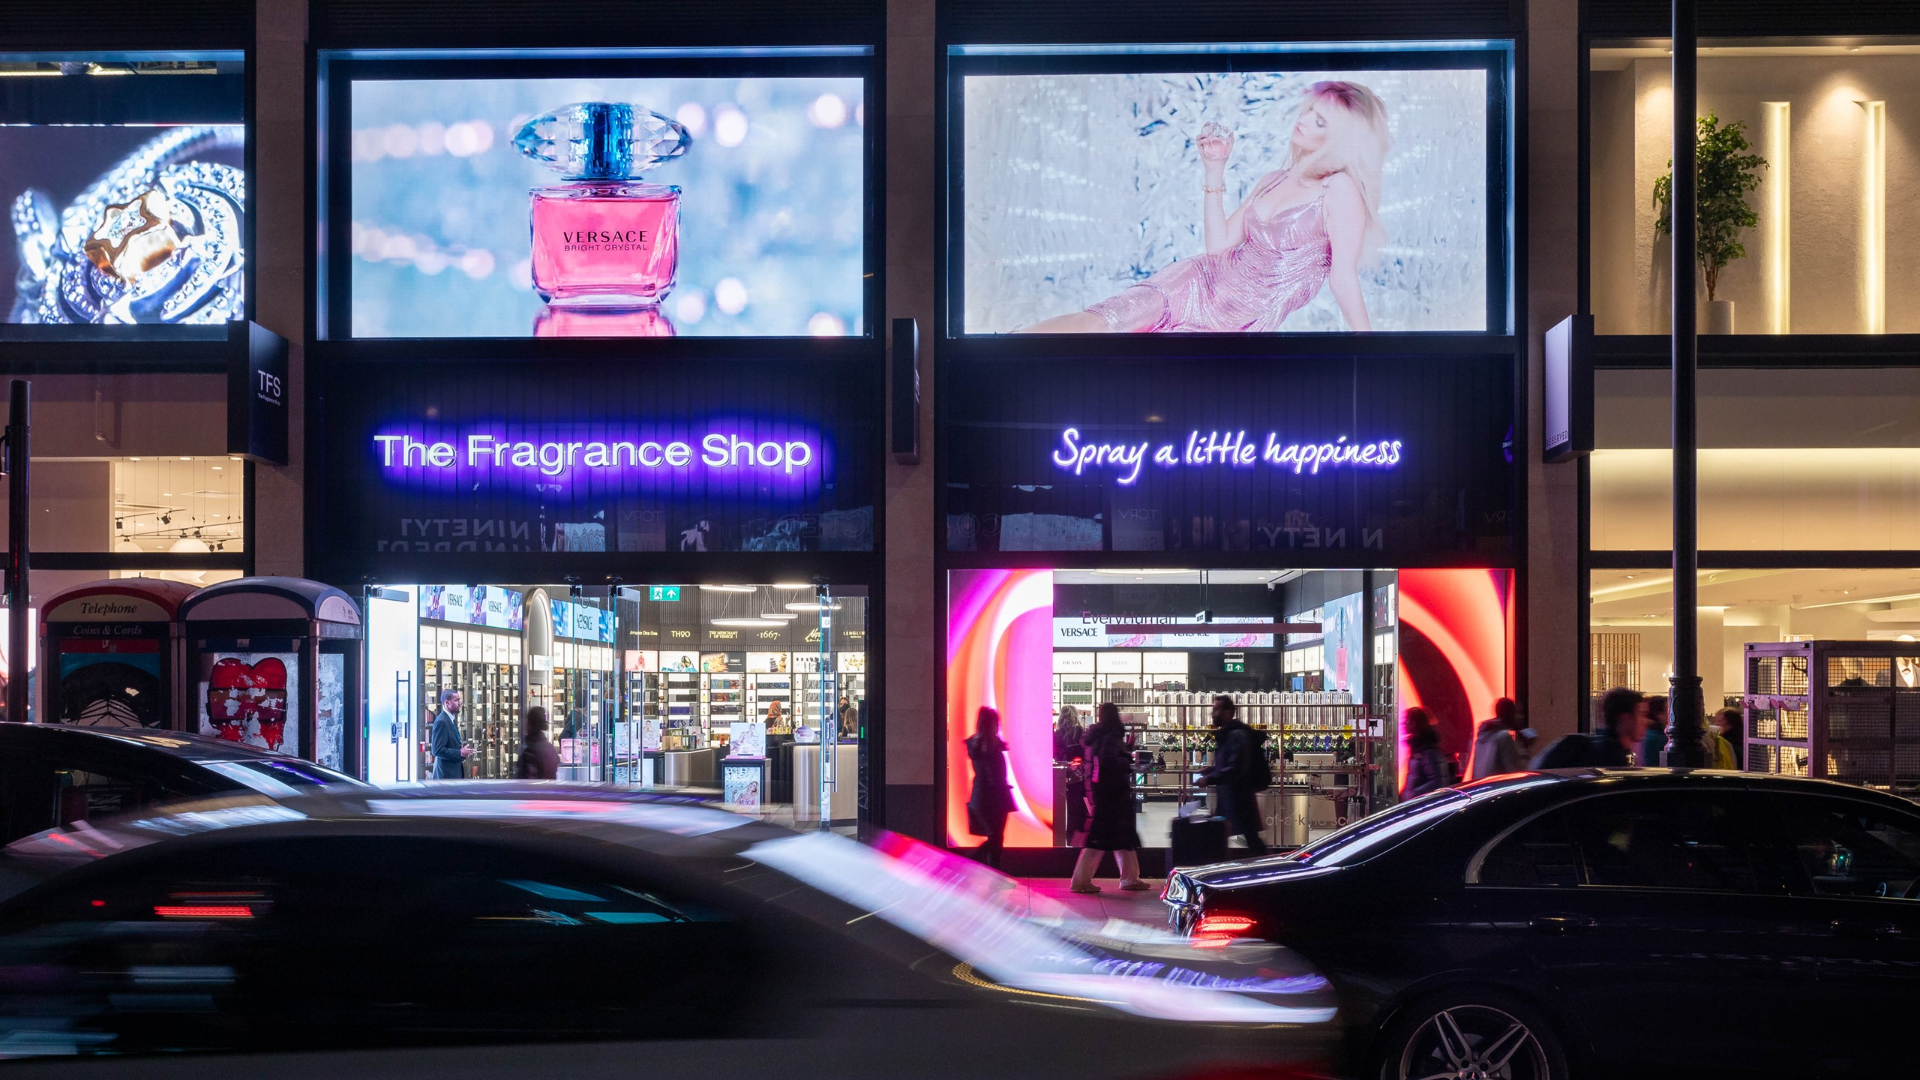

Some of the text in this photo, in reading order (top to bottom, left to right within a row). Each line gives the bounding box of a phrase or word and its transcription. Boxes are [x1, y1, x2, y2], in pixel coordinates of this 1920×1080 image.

[563, 230, 648, 243] VERSACE
[564, 243, 648, 252] BRIGHT CRYSTAL
[257, 369, 281, 398] TFS
[373, 433, 812, 476] The Fragrance Shop
[1053, 427, 1403, 485] Spray a little happiness
[81, 602, 138, 616] Telephone
[73, 625, 143, 635] Coins & Cards
[1060, 628, 1098, 637] VERSACE
